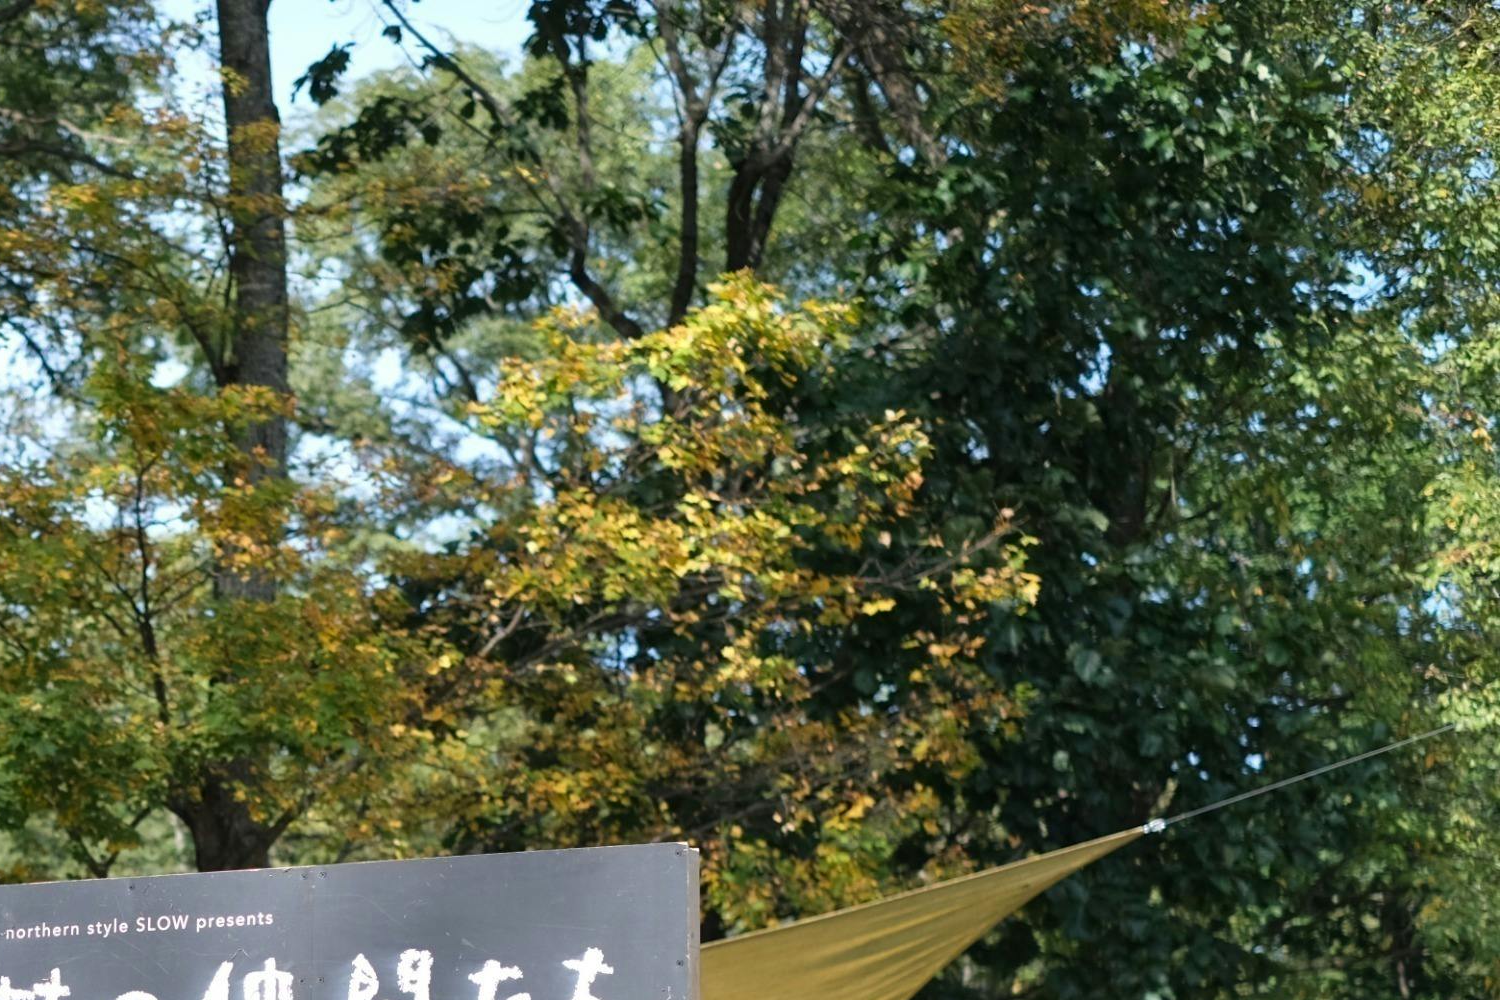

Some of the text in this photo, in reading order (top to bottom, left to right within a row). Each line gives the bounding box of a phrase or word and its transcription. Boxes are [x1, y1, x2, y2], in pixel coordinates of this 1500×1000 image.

[5, 911, 274, 940] northern style SLOW presents
